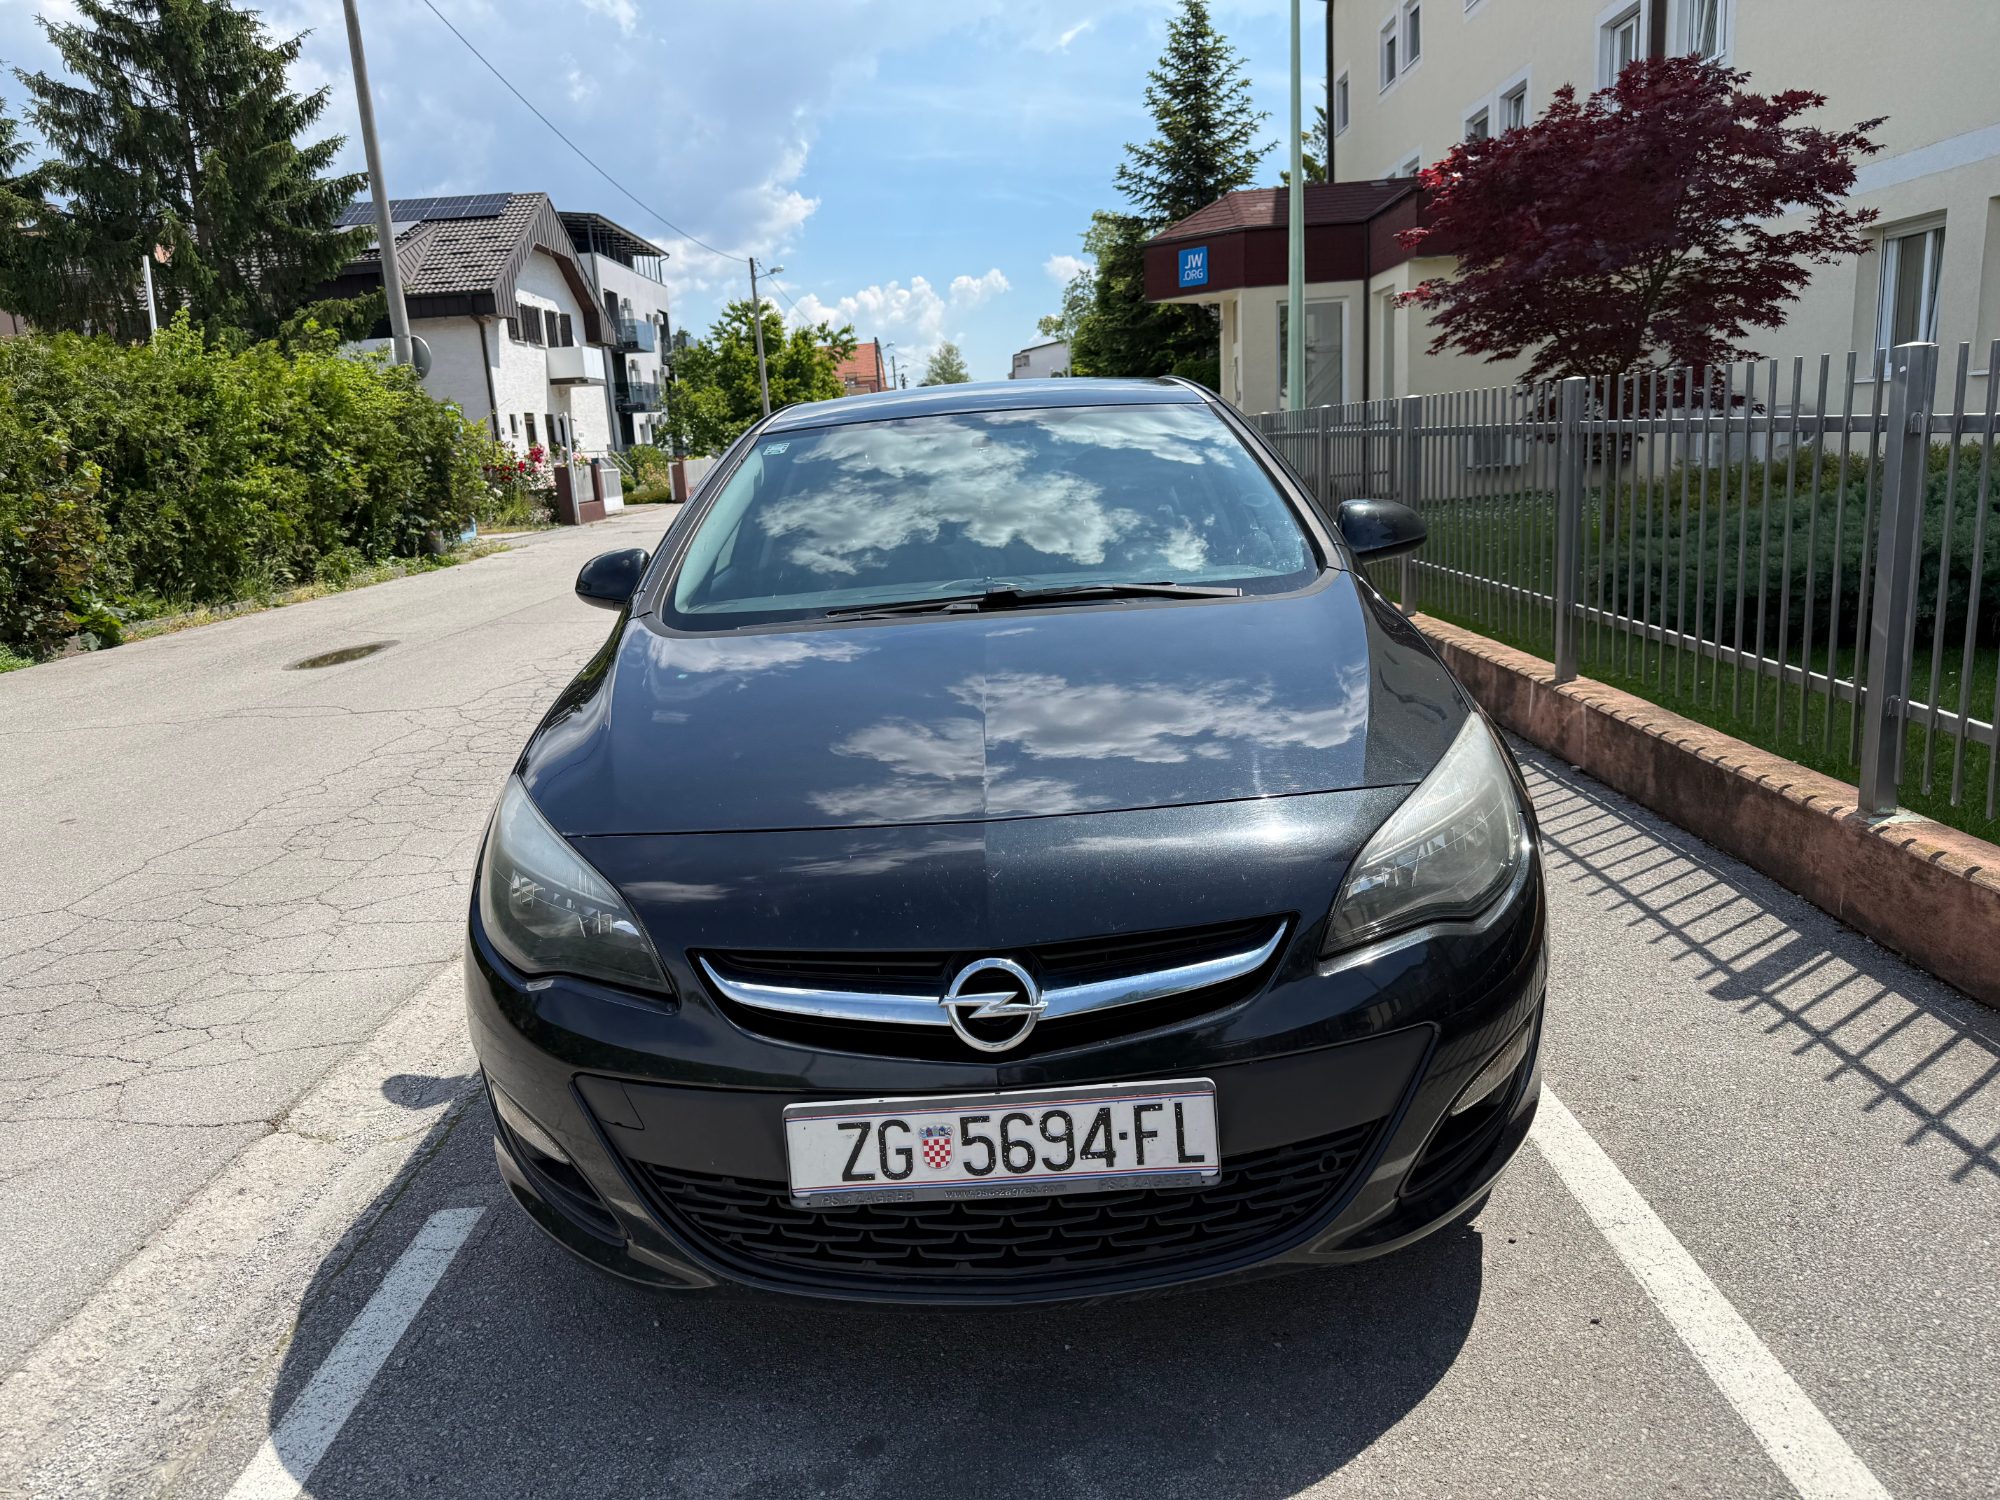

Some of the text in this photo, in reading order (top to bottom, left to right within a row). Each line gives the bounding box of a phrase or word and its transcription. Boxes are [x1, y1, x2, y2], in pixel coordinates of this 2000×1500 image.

[1184, 252, 1203, 269] JW
[1183, 268, 1203, 281] .ORG
[838, 1119, 914, 1181] ZG
